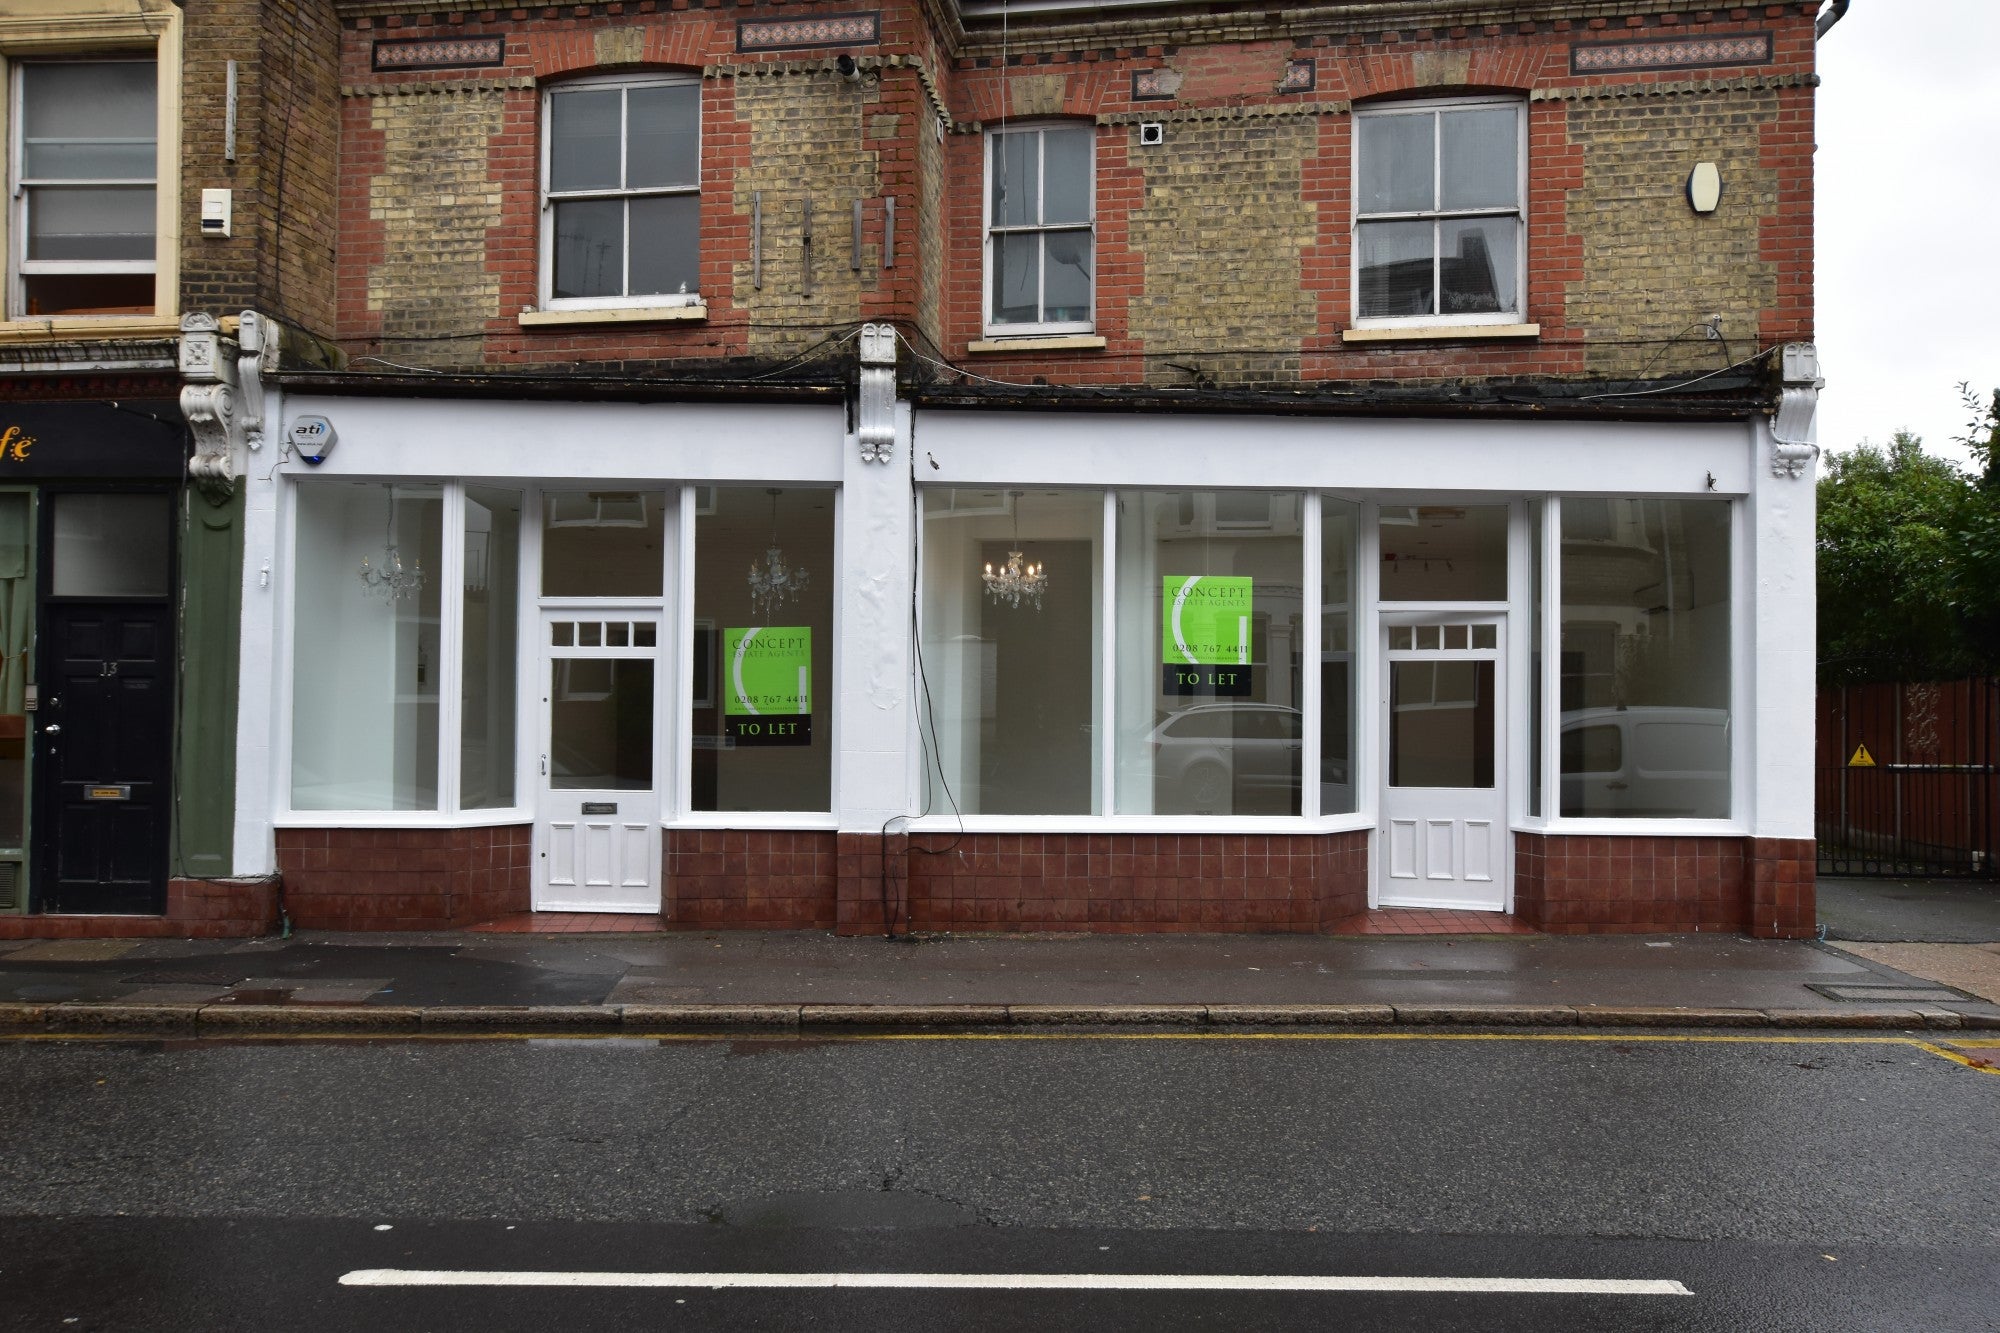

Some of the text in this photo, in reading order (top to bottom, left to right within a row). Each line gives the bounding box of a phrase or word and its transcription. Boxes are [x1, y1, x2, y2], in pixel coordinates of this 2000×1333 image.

[296, 424, 321, 434] ati
[1171, 586, 1246, 598] CONCEPT
[732, 638, 805, 649] CONCEPT
[1172, 644, 1248, 652] 0208 767 4411
[732, 650, 764, 658] ESTATE
[102, 662, 118, 675] 13
[1176, 673, 1238, 685] TO LET
[734, 695, 808, 704] 0208 767 4411
[737, 723, 798, 735] TO LET
